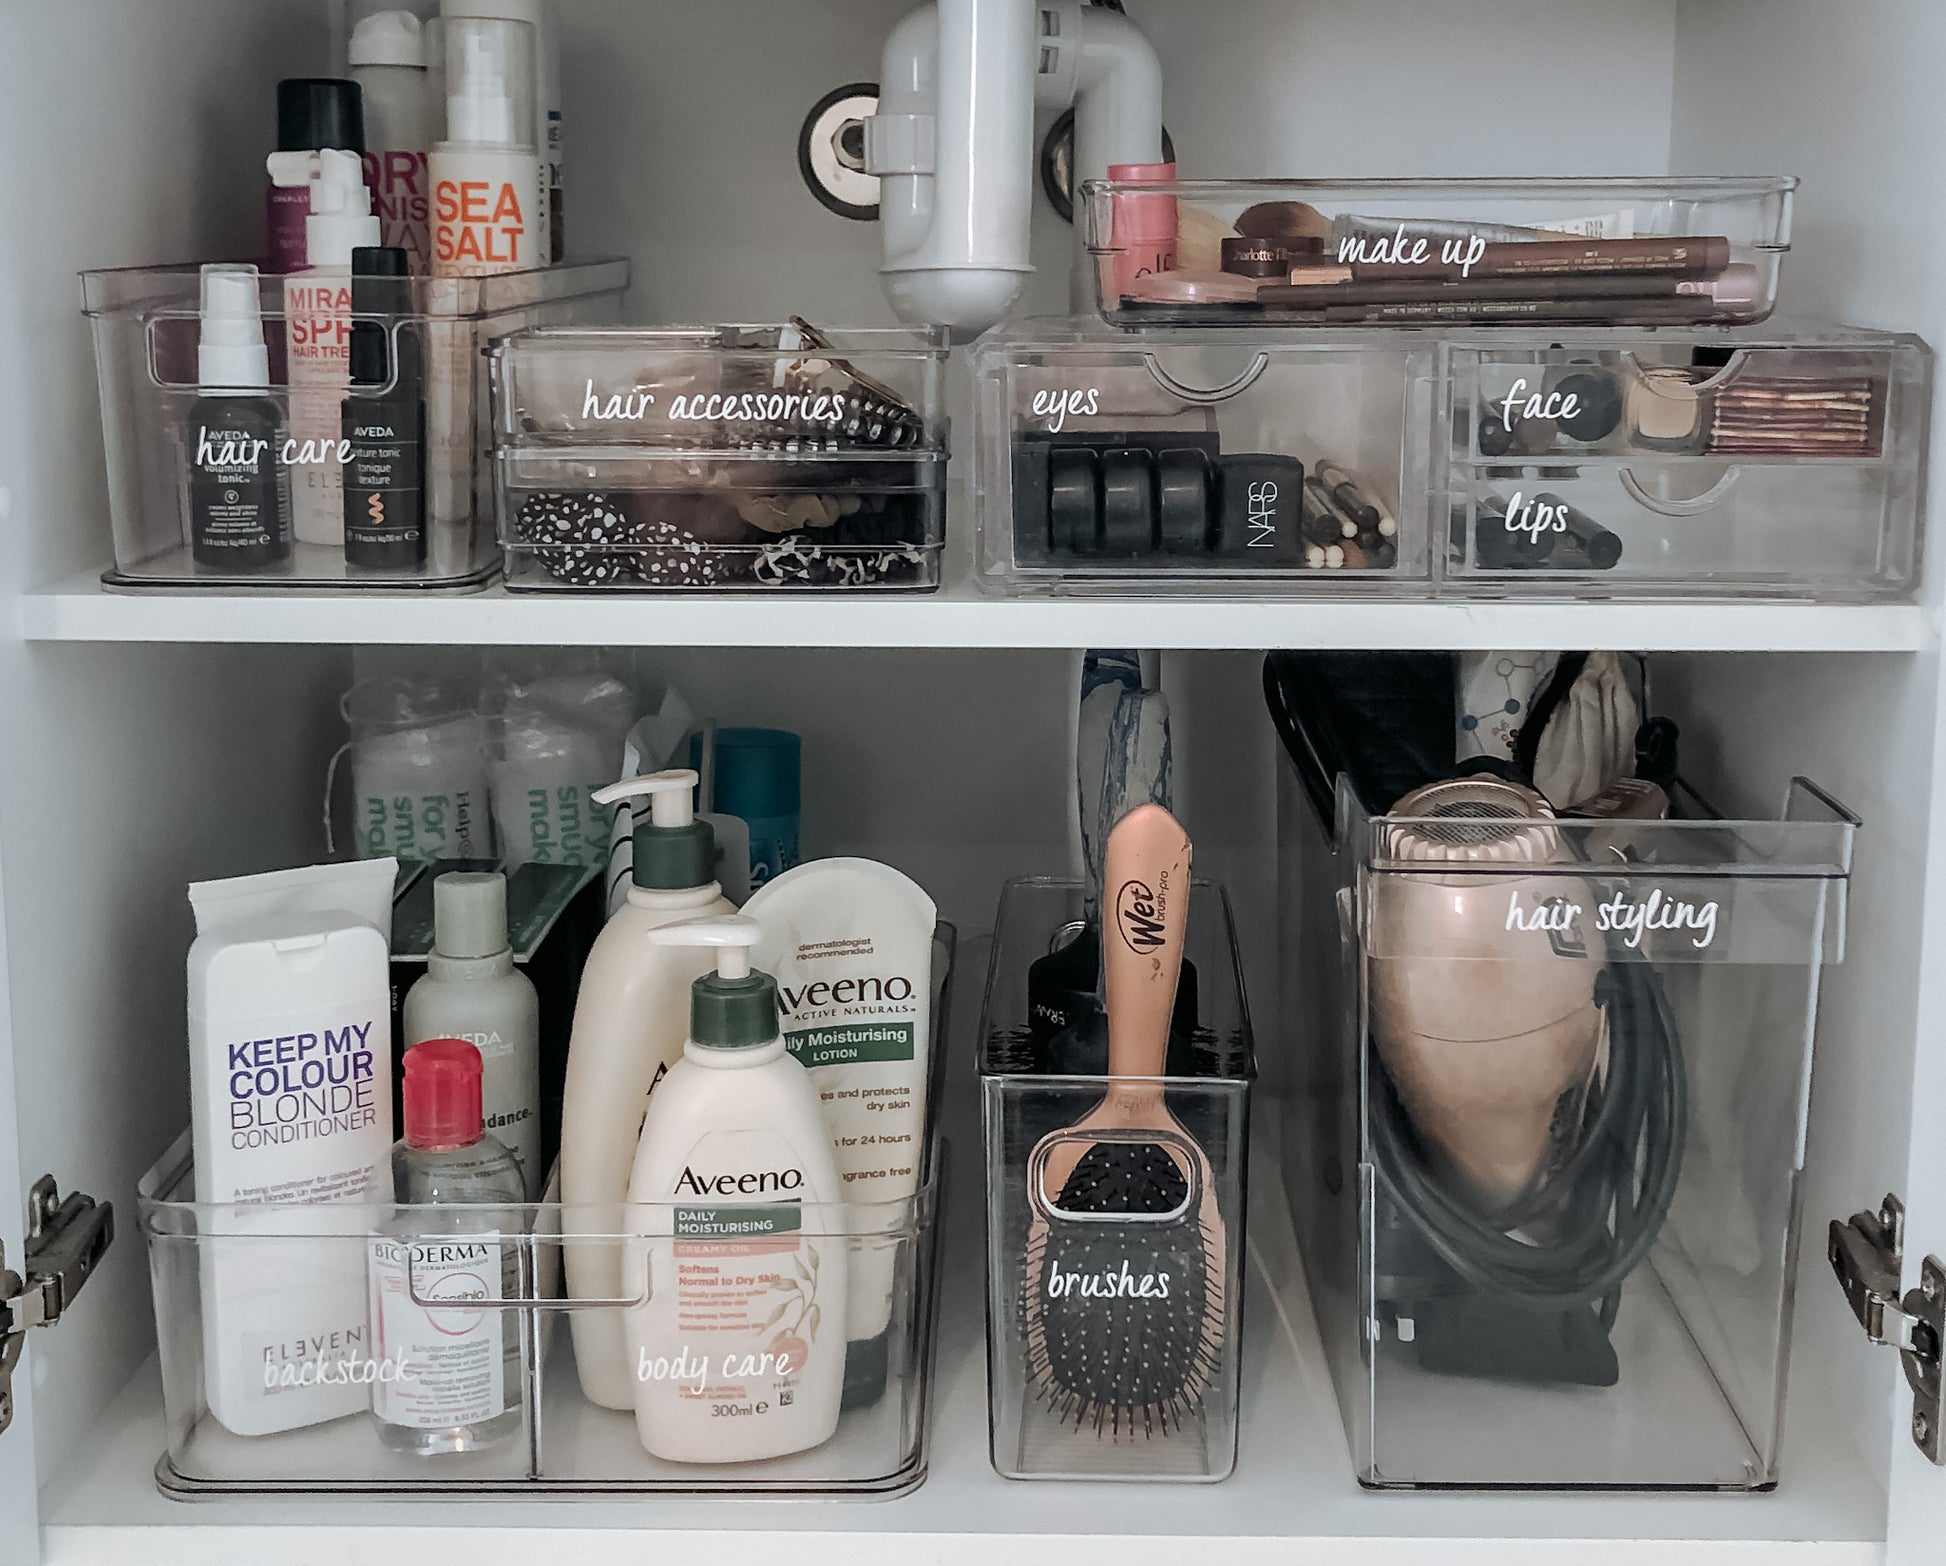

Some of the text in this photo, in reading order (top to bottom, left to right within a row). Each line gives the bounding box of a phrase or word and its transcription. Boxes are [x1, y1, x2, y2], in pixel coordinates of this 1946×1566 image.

[435, 181, 523, 224] SEA
[436, 226, 524, 262] SALT
[1337, 223, 1487, 277] make up
[581, 378, 845, 421] hair accessories
[1032, 386, 1100, 433] eyes
[1500, 378, 1582, 432] face
[196, 425, 356, 466] hair care
[208, 430, 251, 440] AVEDA
[354, 426, 395, 438] AVEDA
[1247, 480, 1278, 549] NARS
[1504, 490, 1569, 544] lips
[1124, 885, 1166, 946] Wet
[1505, 888, 1718, 948] hair styling
[796, 947, 874, 961] recommended
[798, 937, 872, 951] dermatologist
[794, 1004, 909, 1021] ACTIVE NATURALS
[228, 1020, 373, 1071] KEEP MY
[787, 1028, 908, 1051] ily Moisturising
[813, 1048, 858, 1062] LOTION
[229, 1050, 374, 1100] COLOUR
[231, 1077, 375, 1130] BLONDE
[838, 1088, 859, 1098] and
[862, 1086, 910, 1099] protects
[866, 1099, 910, 1111] dry skin
[232, 1108, 377, 1151] CONDITIONER
[842, 1133, 911, 1146] for 24 hours
[674, 1165, 803, 1195] Aveeno
[889, 1166, 911, 1176] free
[678, 1211, 716, 1222] DAILY
[678, 1219, 774, 1234] MOISTURISING
[678, 1244, 728, 1254] CREAMY
[678, 1264, 720, 1275] Softens
[678, 1273, 780, 1287] Normal to Dry Skin
[1047, 1259, 1170, 1299] brushes
[263, 1346, 416, 1387] backstock
[637, 1345, 794, 1395] body care
[711, 1403, 753, 1417] 300ml
